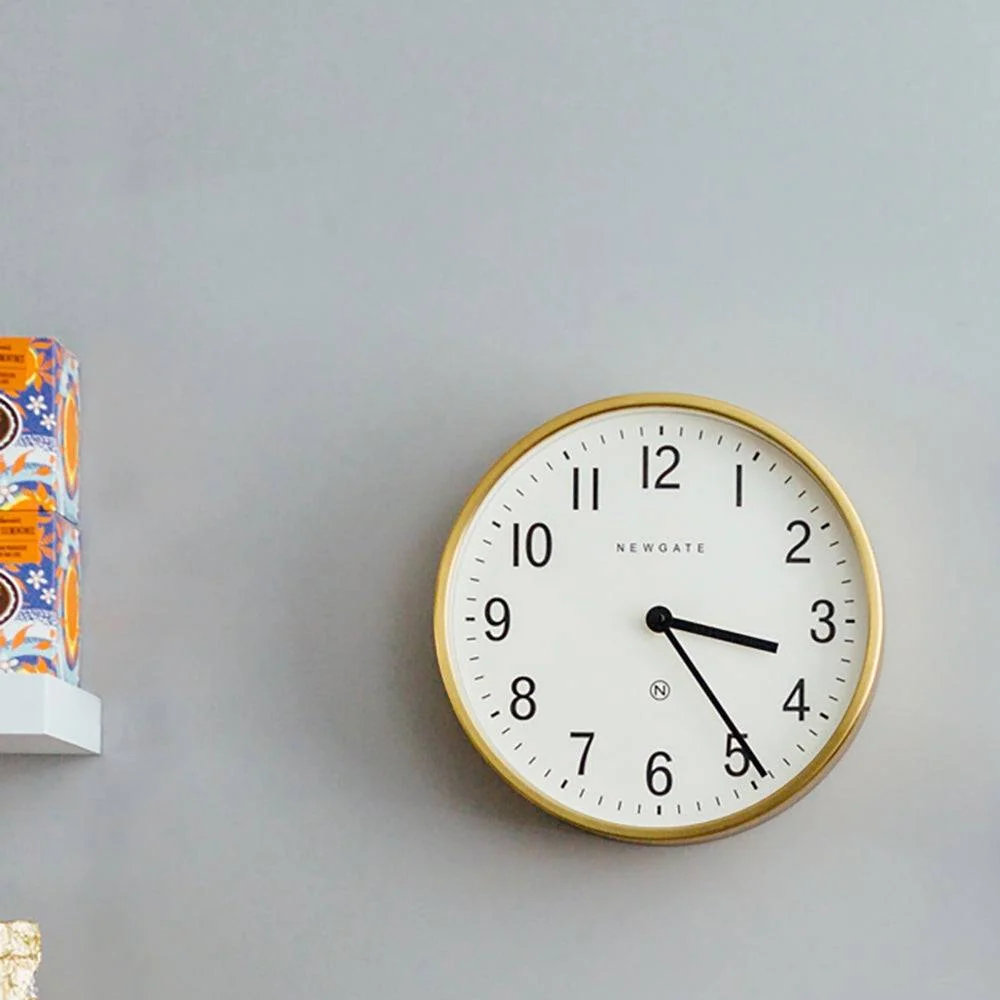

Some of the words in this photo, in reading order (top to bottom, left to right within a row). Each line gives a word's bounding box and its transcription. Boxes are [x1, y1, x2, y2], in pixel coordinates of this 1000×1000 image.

[572, 467, 599, 510] 11
[642, 445, 681, 489] 12
[734, 464, 743, 507] 1
[512, 523, 553, 567] 10
[616, 543, 705, 553] NEWGATE
[785, 520, 811, 563] 2
[484, 597, 510, 641] 9
[810, 599, 836, 643] 3
[510, 676, 536, 720] 8
[783, 679, 810, 721] 4
[569, 732, 595, 775] 7
[646, 751, 672, 796] 6
[724, 733, 750, 777] 5
